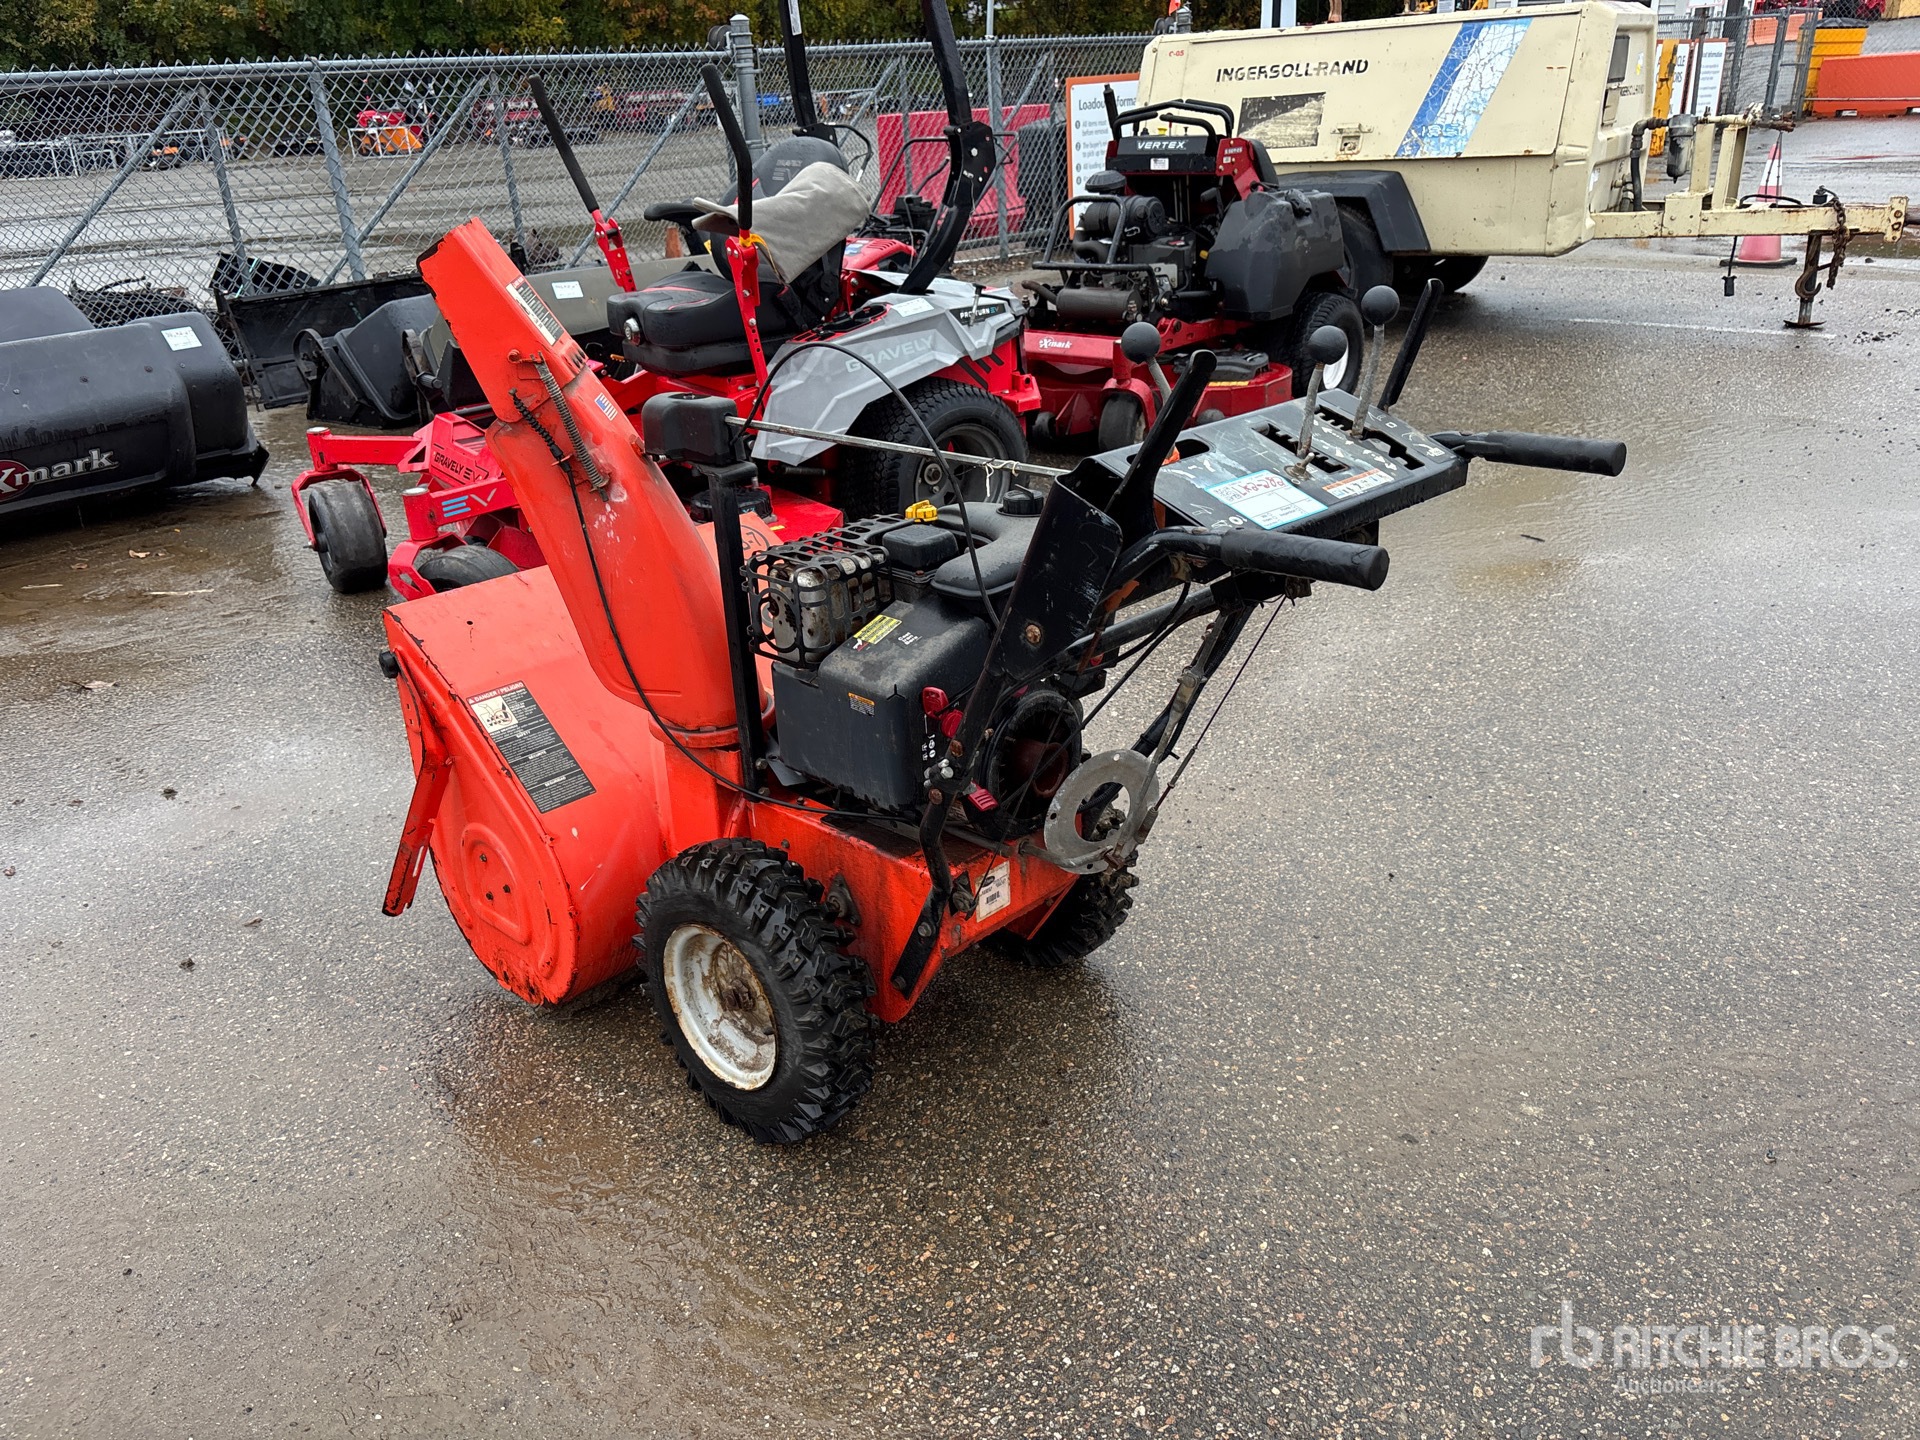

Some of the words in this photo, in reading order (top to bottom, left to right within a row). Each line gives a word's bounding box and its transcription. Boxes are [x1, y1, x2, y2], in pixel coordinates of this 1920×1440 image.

[1078, 97, 1106, 111] Loadou
[1137, 141, 1186, 149] VERTEX
[845, 334, 933, 373] GRAVELY
[434, 451, 465, 476] GRAVELY
